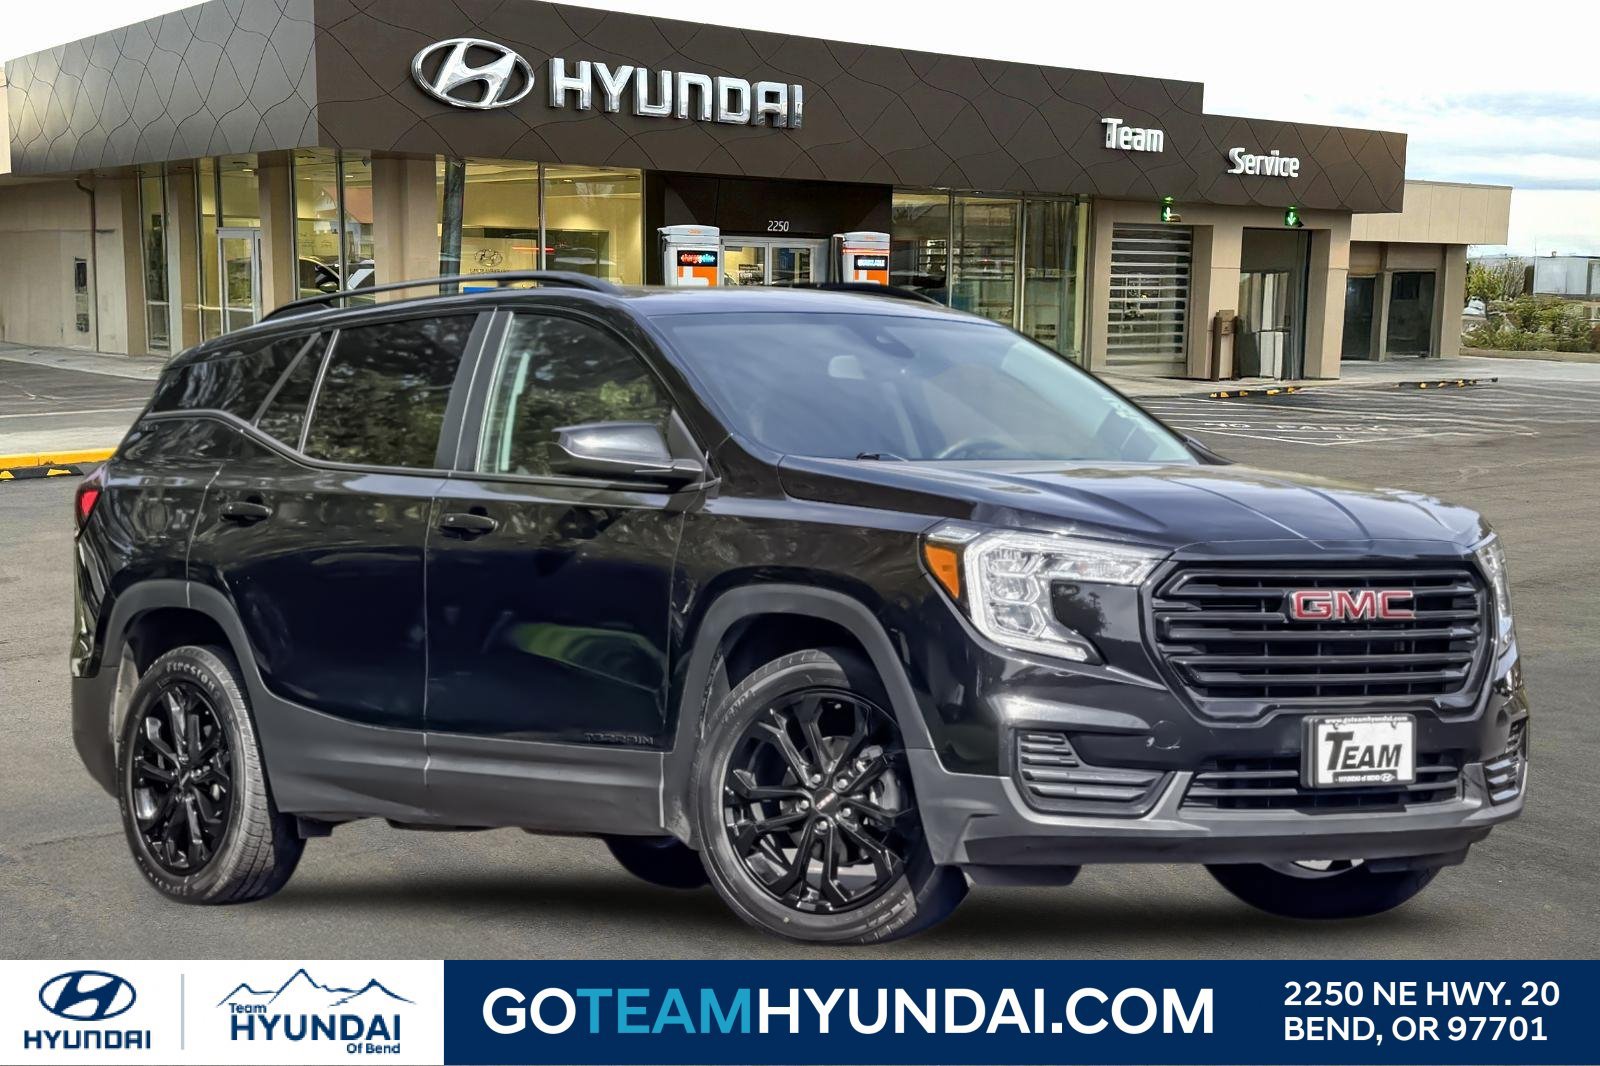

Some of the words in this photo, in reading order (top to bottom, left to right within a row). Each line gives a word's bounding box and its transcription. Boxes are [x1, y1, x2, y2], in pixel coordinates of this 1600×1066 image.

[549, 57, 804, 129] HYUNDAI
[1101, 117, 1164, 153] Team
[1227, 146, 1300, 178] Service
[767, 220, 790, 232] 2250
[1290, 589, 1416, 620] GMC
[1324, 730, 1403, 771] TEAM
